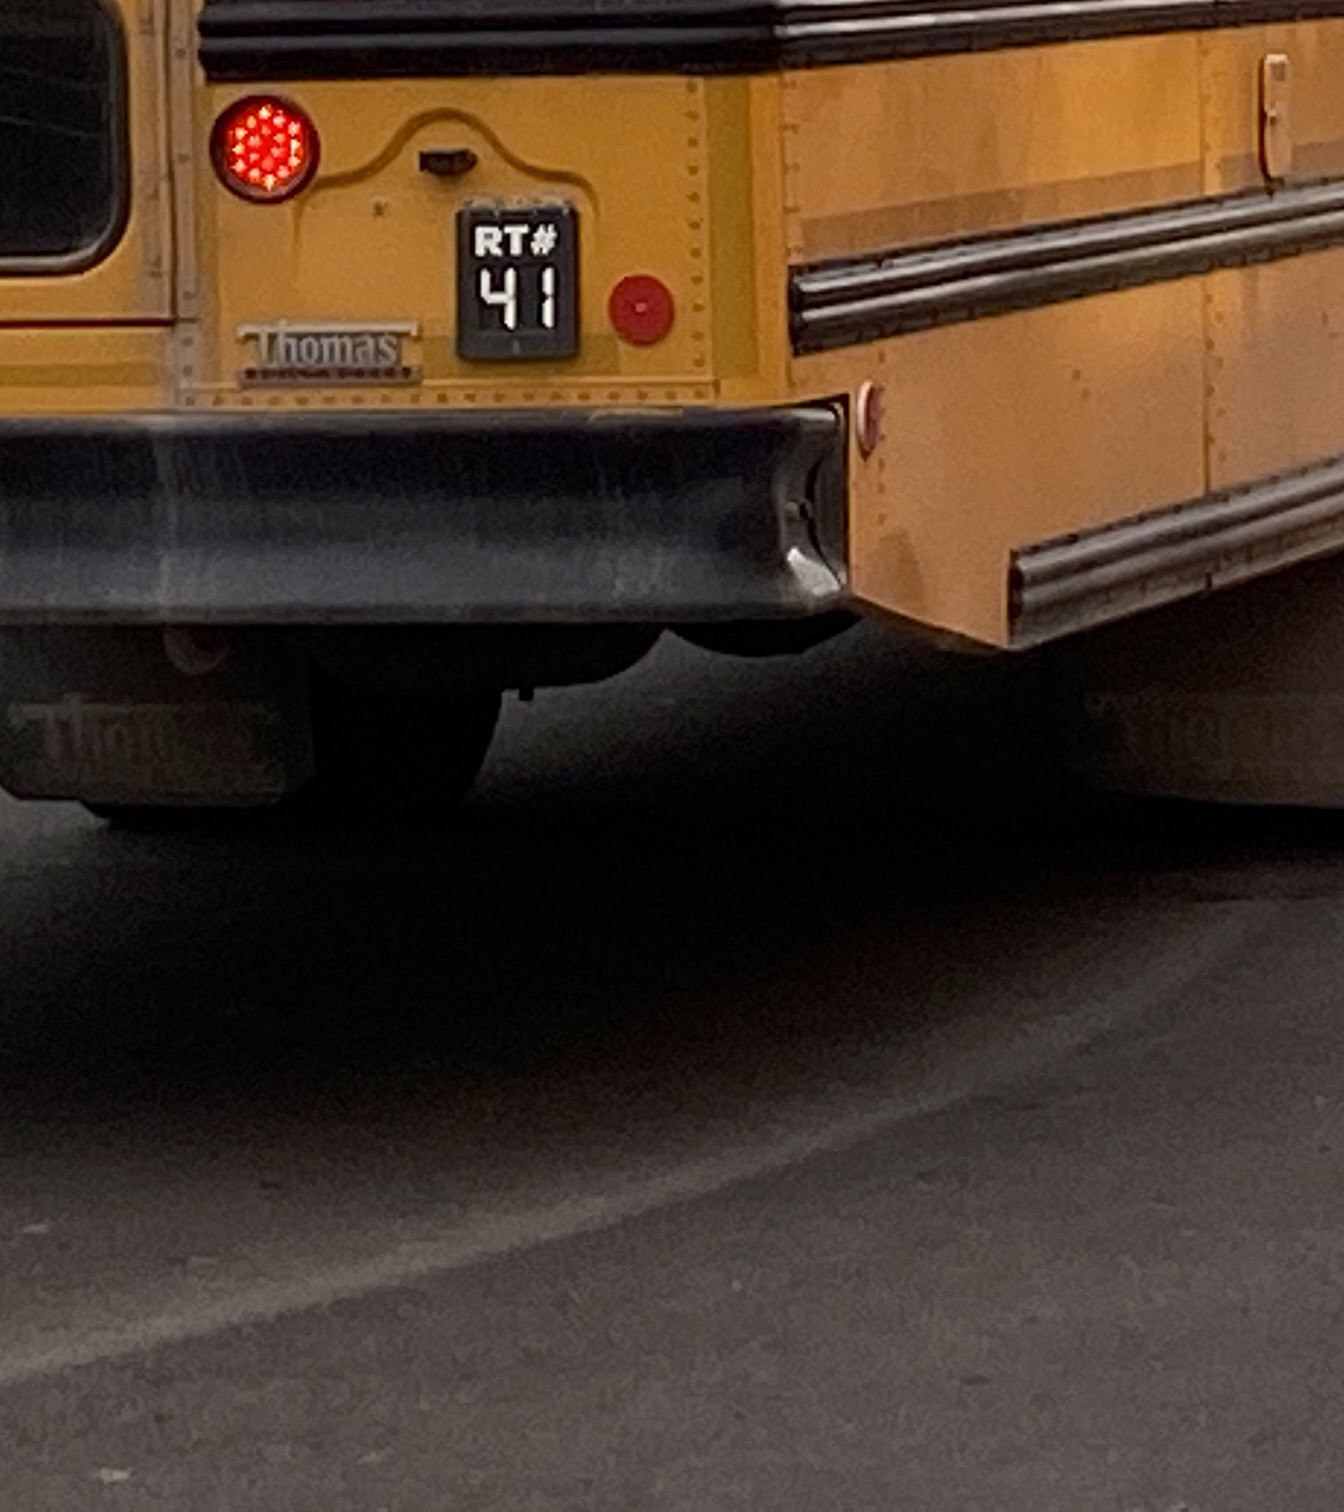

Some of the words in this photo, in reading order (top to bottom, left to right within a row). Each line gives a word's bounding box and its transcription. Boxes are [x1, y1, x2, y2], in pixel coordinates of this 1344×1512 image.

[474, 224, 557, 258] RT#
[479, 266, 555, 330] 41
[236, 319, 419, 368] Thomas
